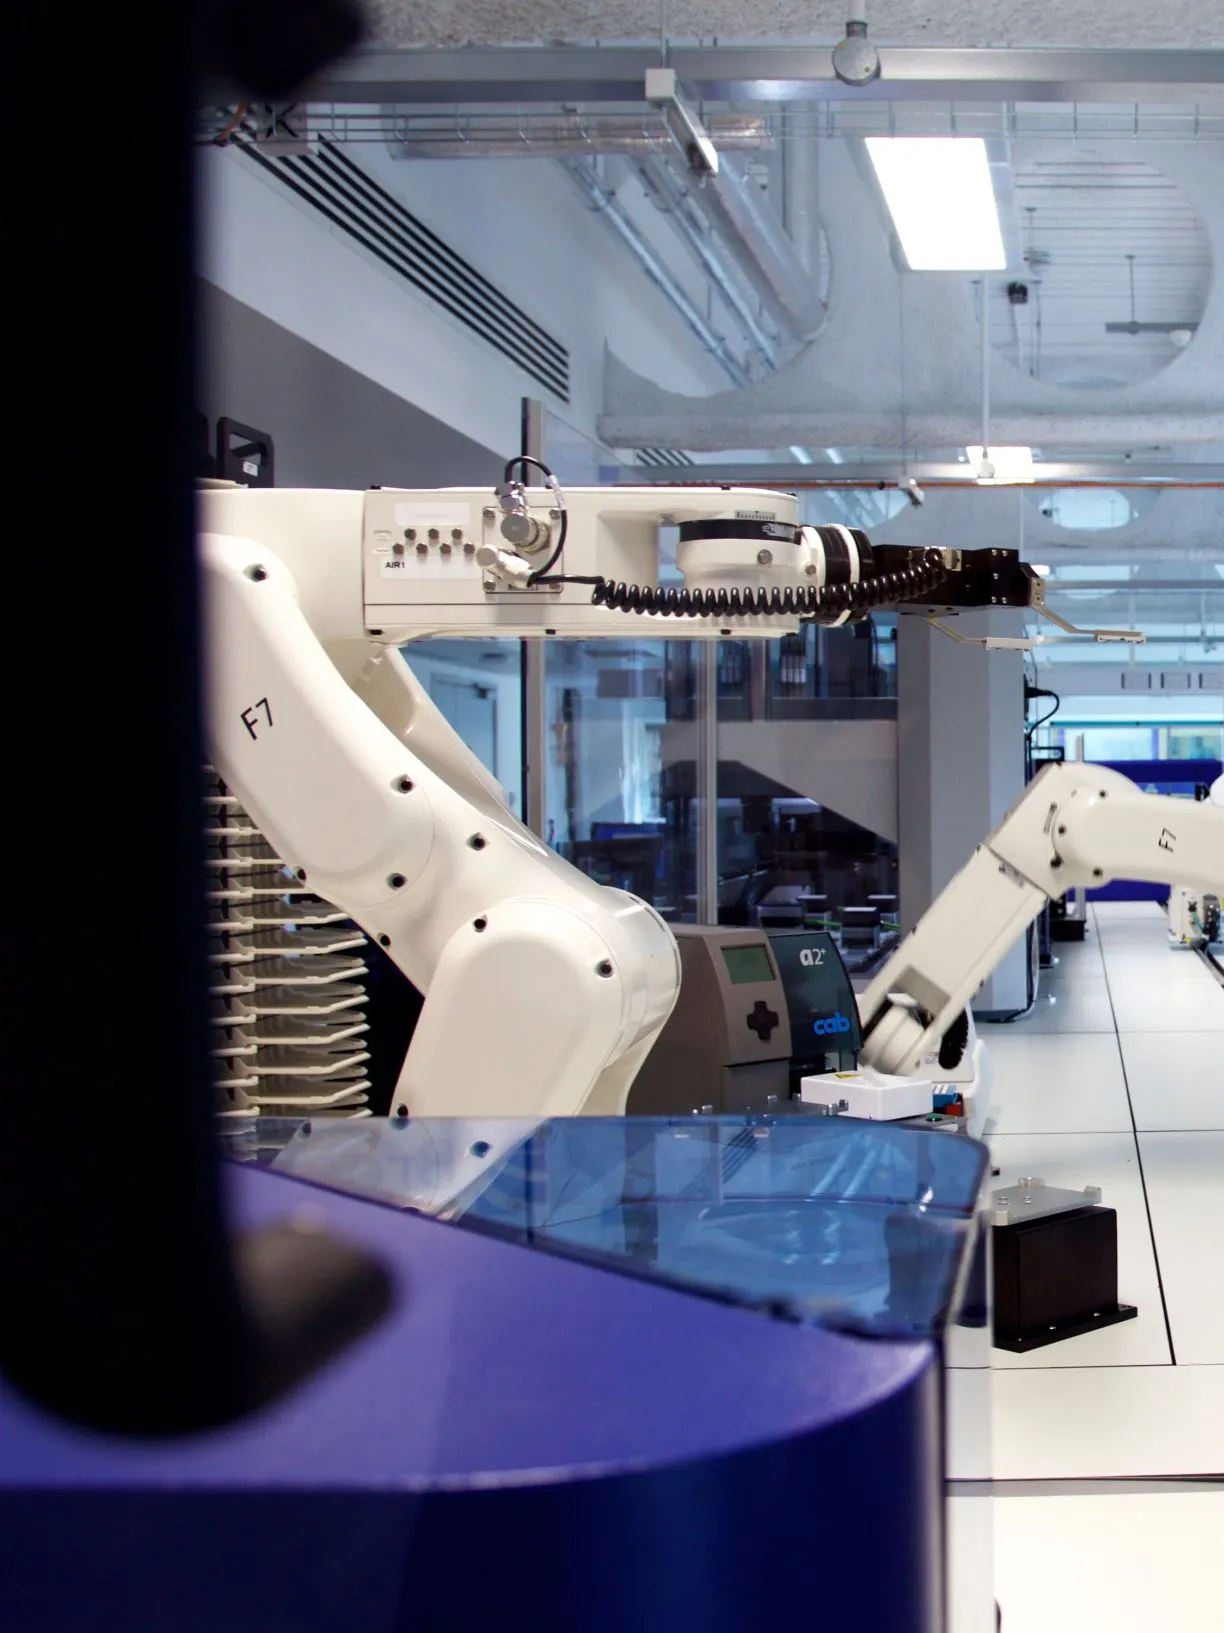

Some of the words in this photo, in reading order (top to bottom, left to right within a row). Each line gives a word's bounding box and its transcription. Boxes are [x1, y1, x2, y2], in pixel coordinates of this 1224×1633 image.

[240, 697, 273, 741] F7
[1158, 828, 1177, 853] F7
[813, 1011, 850, 1035] cab
